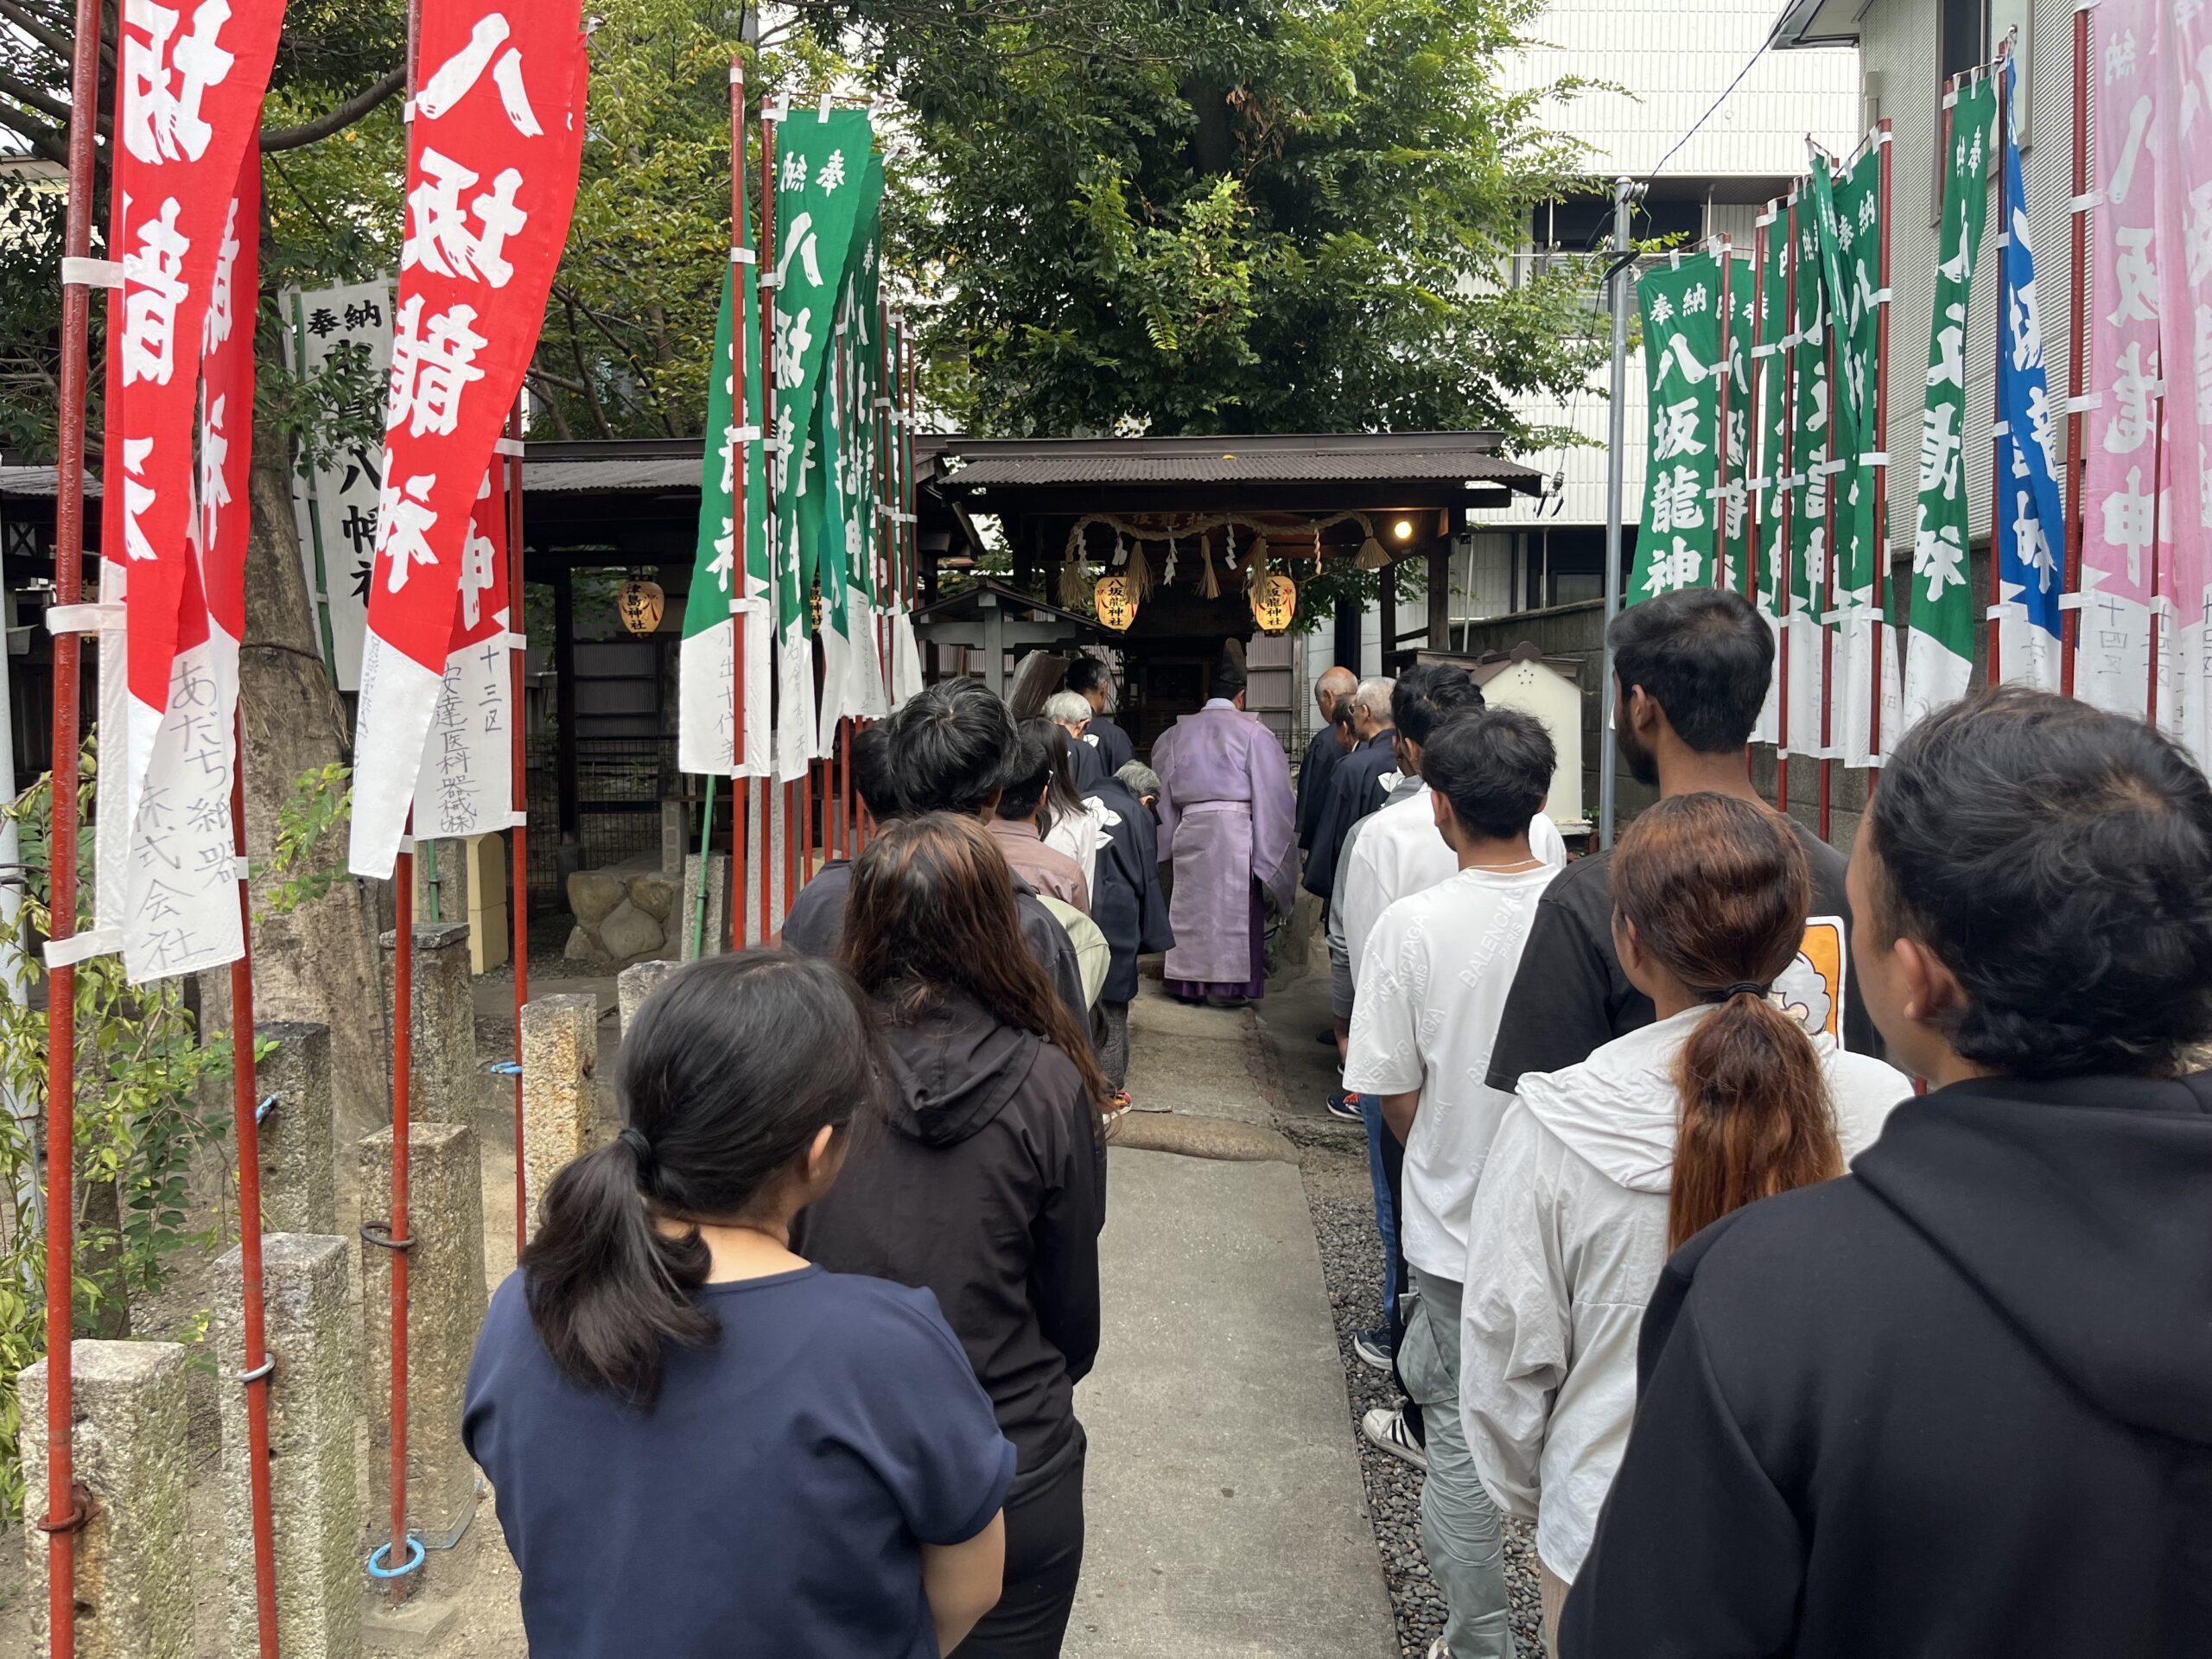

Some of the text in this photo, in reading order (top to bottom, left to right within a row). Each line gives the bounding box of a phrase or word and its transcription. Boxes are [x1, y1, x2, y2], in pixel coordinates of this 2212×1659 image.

[1839, 189, 1875, 255] 奉納
[307, 300, 382, 339] 奉納
[1649, 283, 1707, 326] 奉納
[1641, 332, 1709, 598] 八坂龍神
[626, 584, 646, 629] 津島神社
[1108, 579, 1125, 626] 八坂龍神社
[478, 645, 502, 734] 十三区
